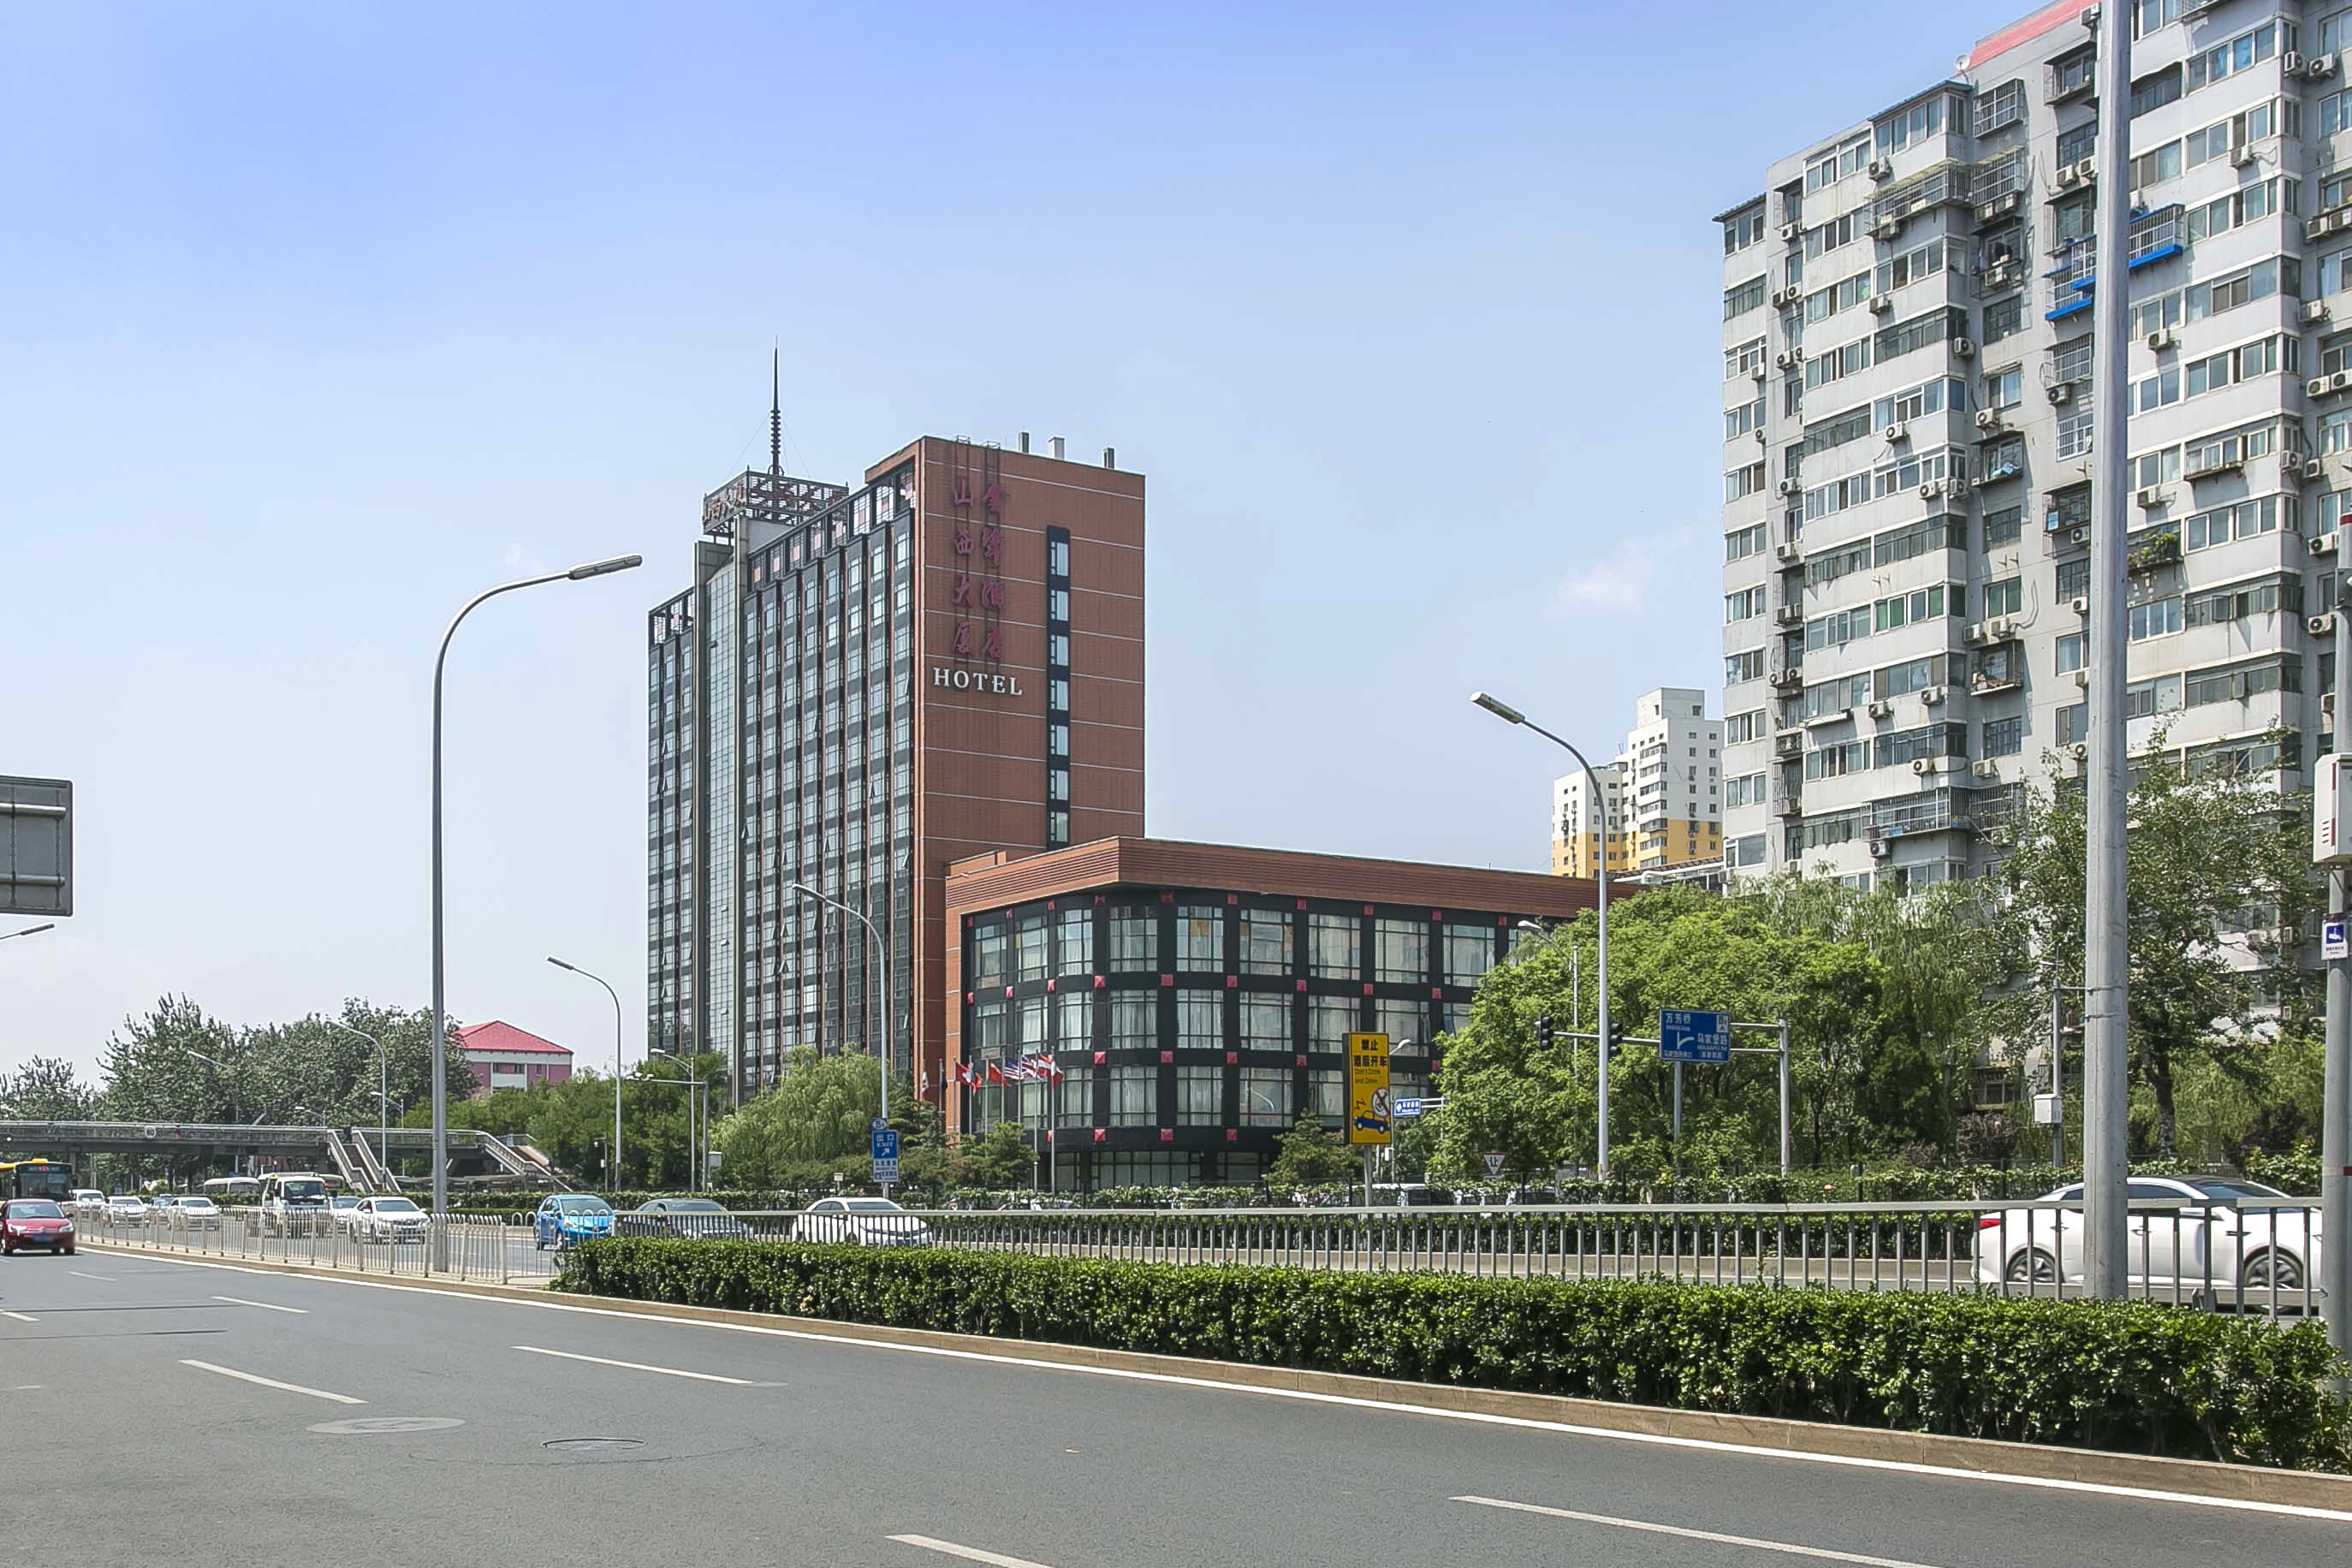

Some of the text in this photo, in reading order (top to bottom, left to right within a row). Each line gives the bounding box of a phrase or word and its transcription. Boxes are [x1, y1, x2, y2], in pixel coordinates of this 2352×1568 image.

[953, 478, 974, 657] 山西大厦
[933, 667, 1023, 696] HOTEL
[1665, 1013, 1691, 1025] 万芳桥
[1361, 1039, 1379, 1051] 禁止
[1353, 1054, 1387, 1067] 酒后开车
